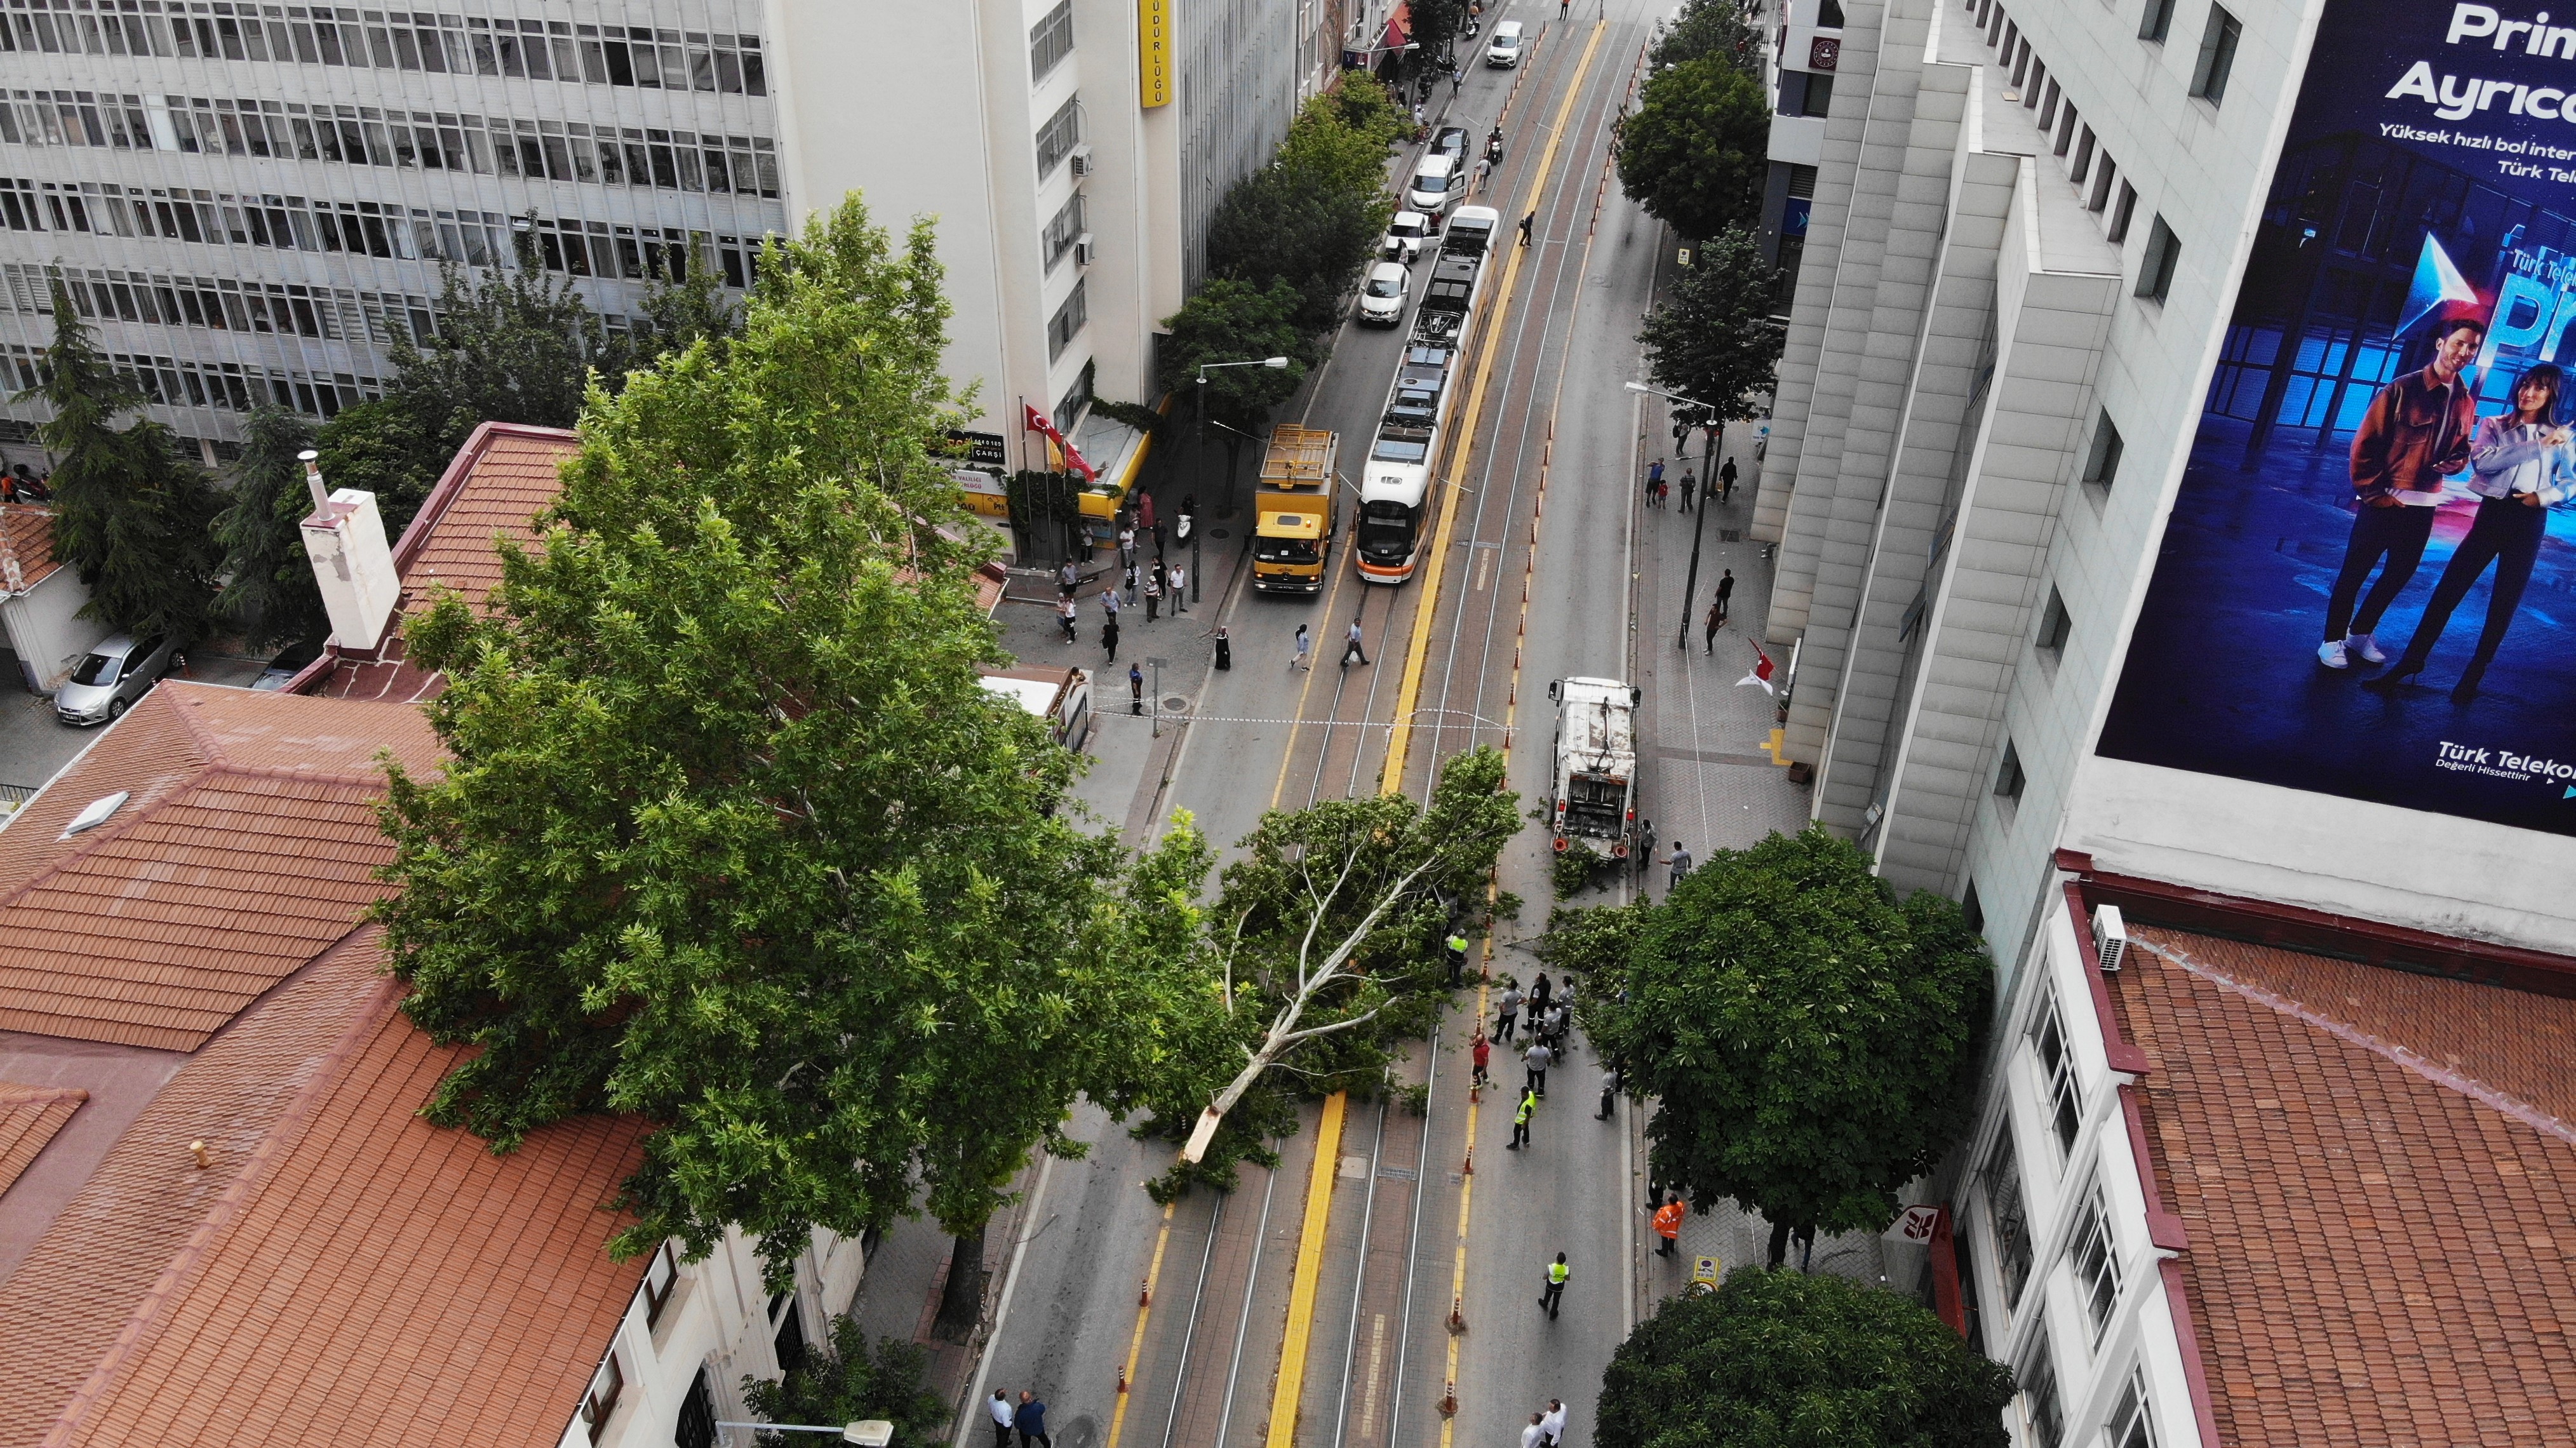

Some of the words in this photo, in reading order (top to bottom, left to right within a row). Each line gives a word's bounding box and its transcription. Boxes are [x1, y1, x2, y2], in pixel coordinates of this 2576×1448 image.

[2380, 123, 2451, 144] Yüksek
[2453, 132, 2491, 149] hızlı
[2495, 138, 2527, 154] bol
[2499, 161, 2544, 178] Türk
[2548, 167, 2576, 184] Tel
[2512, 249, 2543, 275] Türk
[2435, 759, 2476, 772] Değerli
[2478, 766, 2531, 781] Hissettirir
[2439, 741, 2490, 764] Türk
[2498, 751, 2576, 779] Teleko
